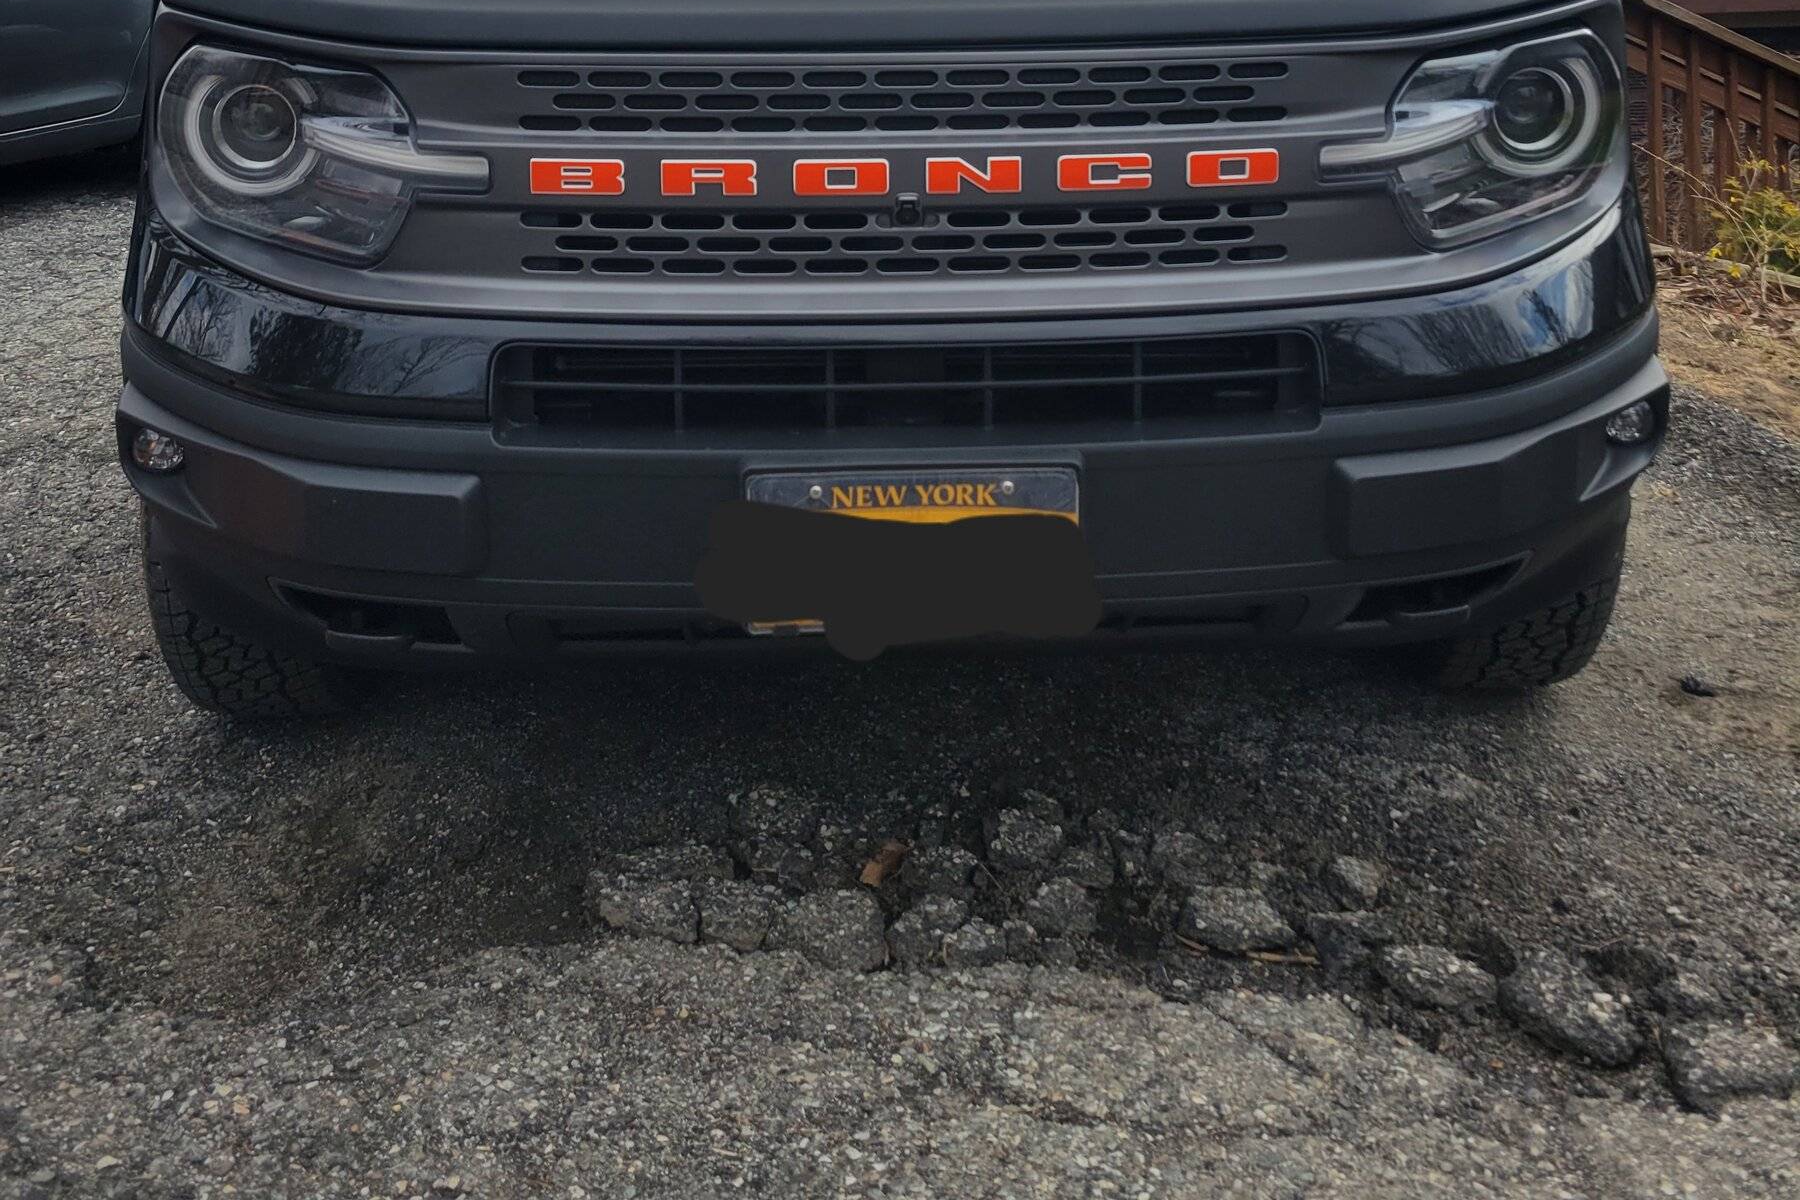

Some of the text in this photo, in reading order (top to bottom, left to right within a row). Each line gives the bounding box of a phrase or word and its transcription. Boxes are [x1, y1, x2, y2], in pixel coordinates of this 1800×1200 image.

[529, 148, 1280, 196] BRONCO
[830, 483, 999, 509] NEW YORK
